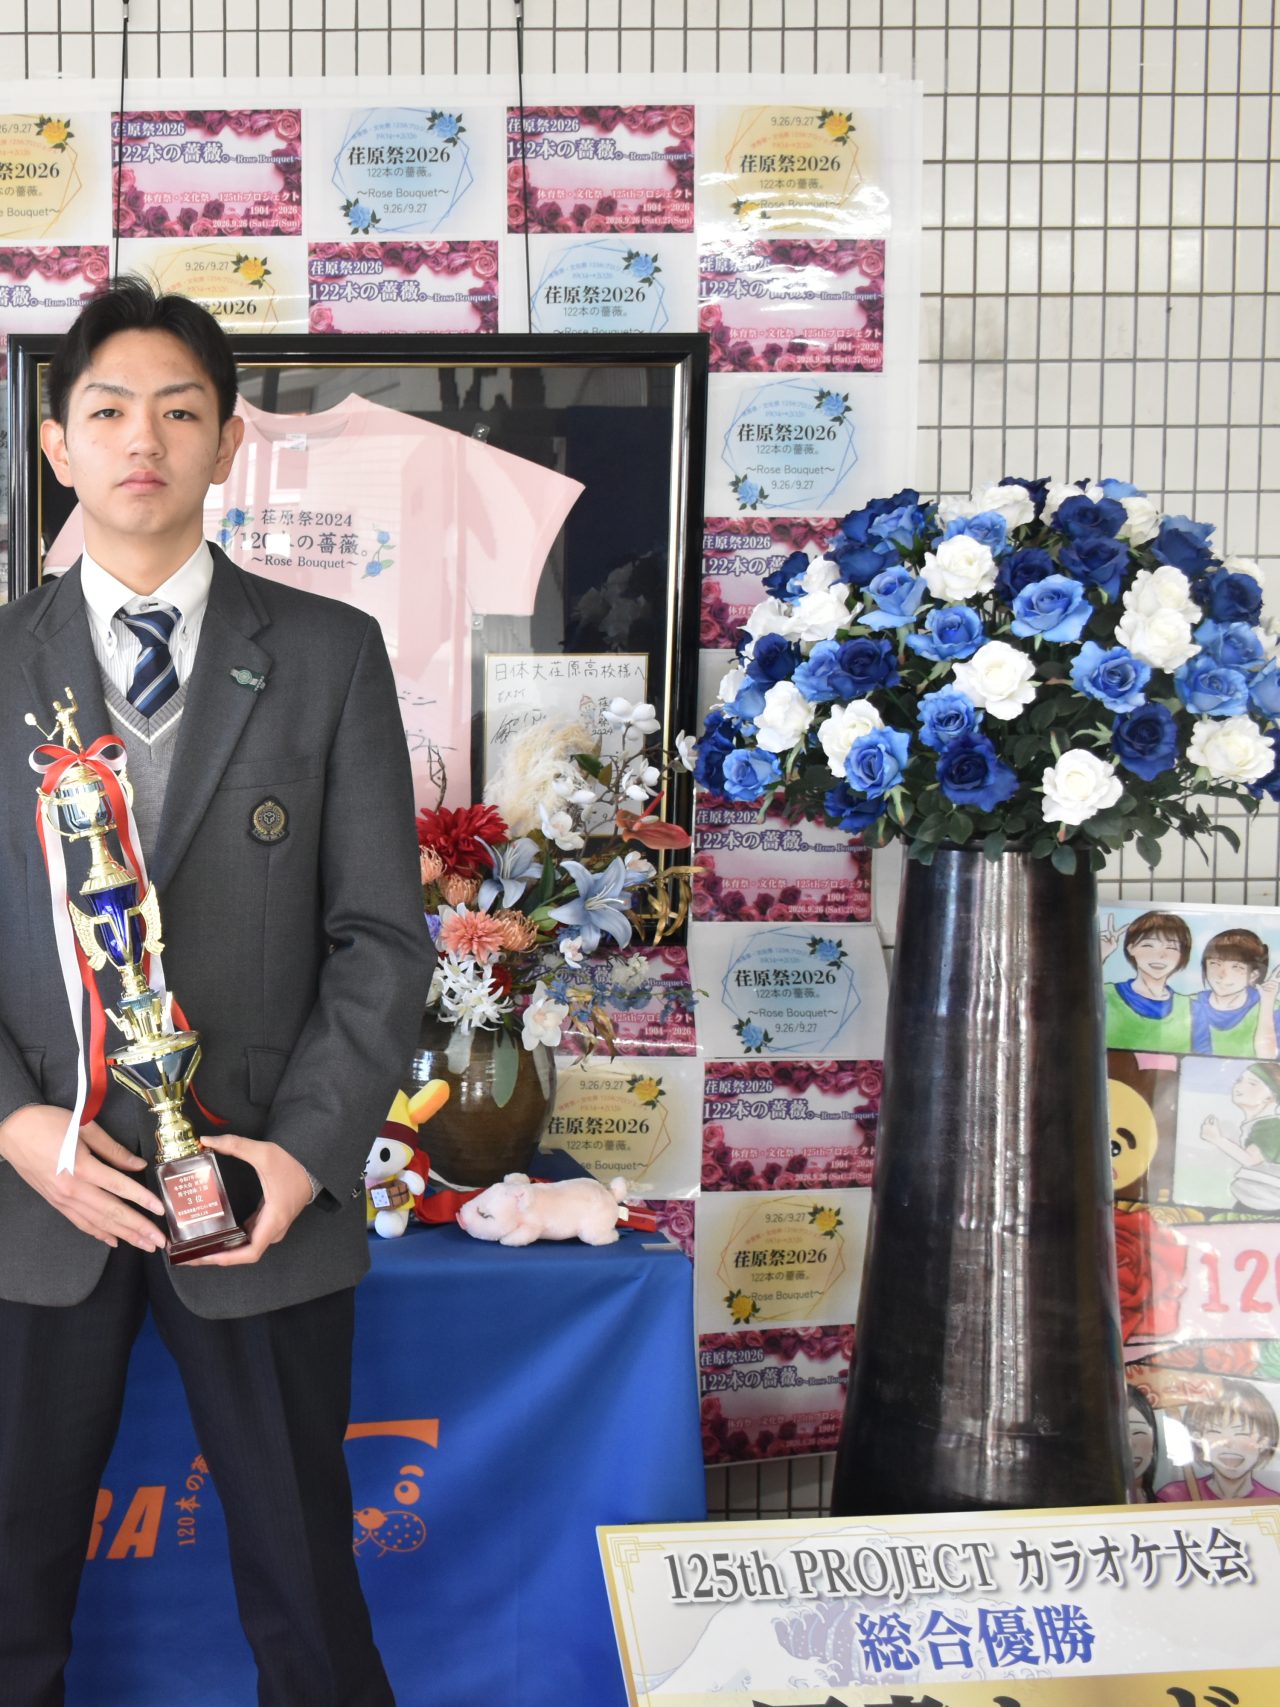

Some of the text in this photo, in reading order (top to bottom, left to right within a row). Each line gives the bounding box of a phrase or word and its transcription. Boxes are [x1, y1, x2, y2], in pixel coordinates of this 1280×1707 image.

[113, 122, 185, 137] 荏原祭2026
[508, 117, 579, 133] 荏原祭2026
[770, 118, 814, 130] 9.26/9.27
[112, 142, 230, 163] 122本の薔薇。
[348, 146, 450, 165] 荏原祭2026
[507, 137, 624, 159] 122本の薔薇。
[367, 167, 431, 177] 122本の薔薇。
[740, 154, 841, 175] 荏原祭2026
[760, 178, 824, 190] 122本の薔薇。
[383, 203, 426, 213] 9.26/9.27
[187, 262, 230, 274] 9.26/9.27
[310, 260, 382, 277] 荏原祭2026
[309, 281, 427, 304] 122本の薔薇。
[544, 286, 646, 305] 荏原祭2026
[563, 307, 627, 317] 122本の薔薇。
[737, 424, 837, 443] 荏原祭2026
[756, 444, 818, 455] 122本の薔薇。
[771, 480, 814, 490] 9.26/9.27
[261, 509, 352, 527] 荏原祭2024
[240, 530, 368, 557] 12の薔薇。
[703, 535, 773, 552] 荏原祭2026
[695, 809, 763, 827] 荏原祭202
[694, 830, 808, 853] 122本の薔薇。
[735, 968, 836, 988] 荏原祭2026
[756, 989, 819, 1000] 122本の薔薇。
[775, 1024, 817, 1034] 9.26/9.27
[578, 1079, 623, 1091] 9.26/9.27
[705, 1079, 773, 1096] 荏原祭2026
[703, 1100, 815, 1122] 122本の薔薇。
[548, 1116, 649, 1137] 荏原祭2026
[567, 1140, 632, 1152] 122本の薔薇。
[765, 1213, 806, 1224] 9.26/9.27
[734, 1248, 827, 1268] 荏原祭2026
[753, 1270, 812, 1282] 122本の薔薇。
[701, 1347, 764, 1366] 荏原祭2026
[701, 1366, 804, 1390] 122本の薔薇。
[664, 1527, 1251, 1601] 125th PROJECT カラオケ大会
[857, 1603, 1095, 1674] 総合優勝
